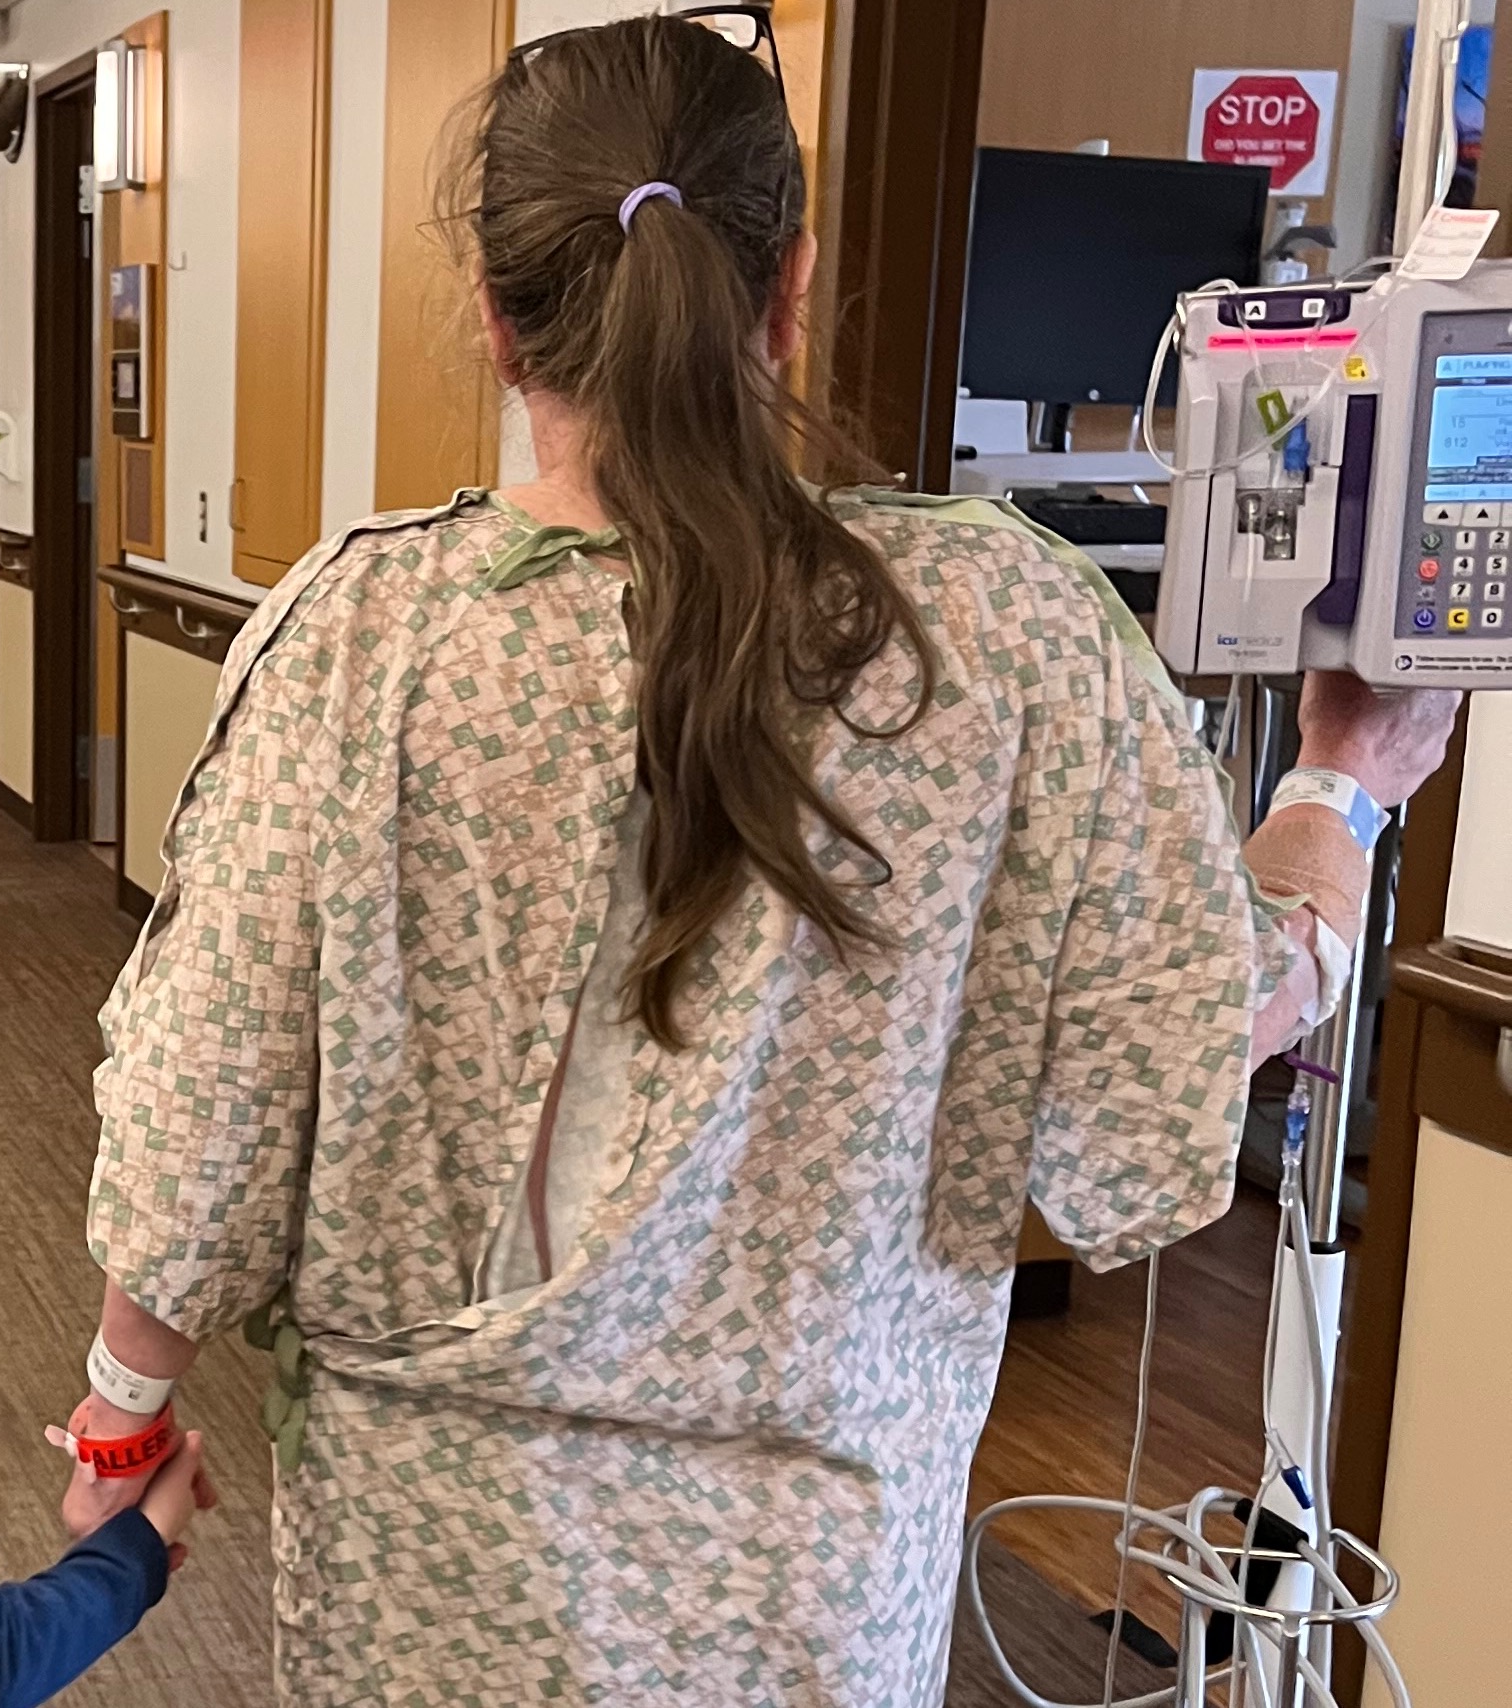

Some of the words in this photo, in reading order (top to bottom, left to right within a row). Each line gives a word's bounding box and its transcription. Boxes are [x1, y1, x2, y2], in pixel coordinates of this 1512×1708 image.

[1218, 95, 1306, 126] STOP
[1249, 305, 1261, 316] A
[1494, 532, 1504, 543] 2
[1459, 558, 1469, 569] 4
[1492, 558, 1502, 569] 5
[1456, 584, 1466, 596] 7
[1490, 584, 1500, 596] 8
[1453, 612, 1465, 624] C
